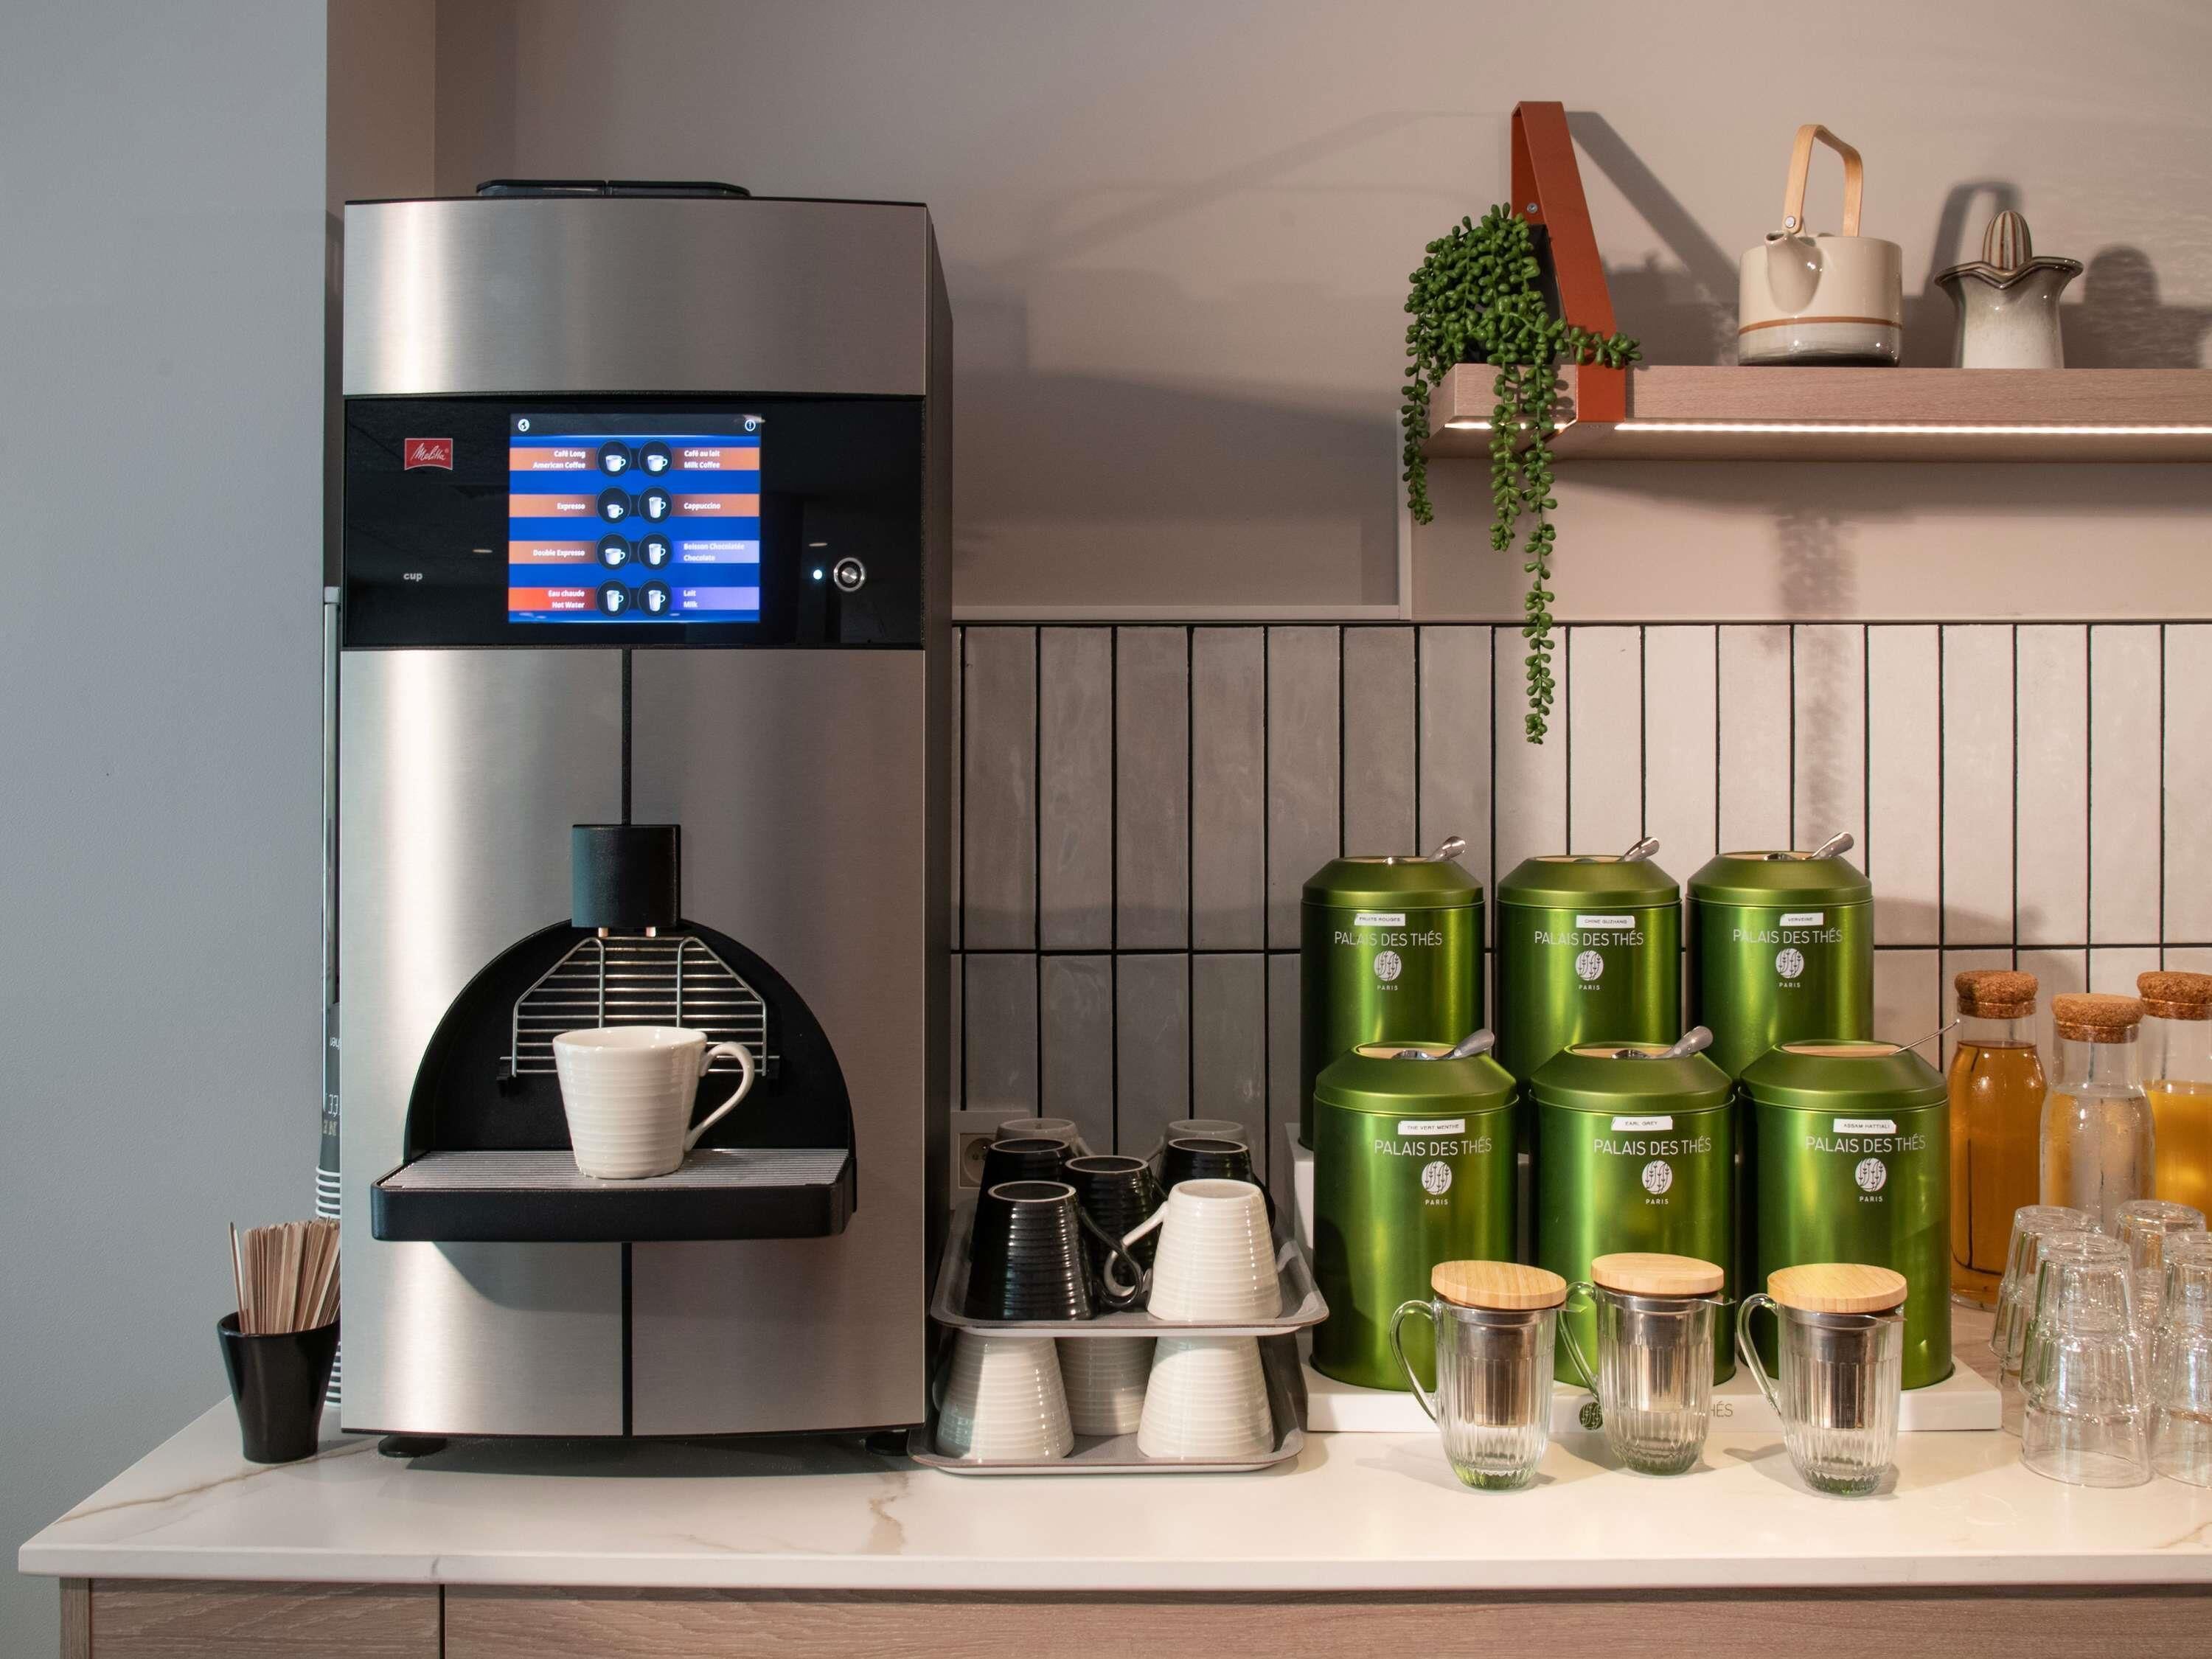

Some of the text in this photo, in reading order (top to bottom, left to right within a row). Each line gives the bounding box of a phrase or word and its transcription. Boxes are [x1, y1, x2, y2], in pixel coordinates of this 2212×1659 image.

[569, 450, 585, 459] Long
[557, 503, 585, 511] Expresso
[684, 502, 721, 511] Cappuccino
[557, 549, 585, 558] Expresso
[403, 573, 422, 582] cup
[1335, 930, 1442, 947] PALAIS DES THÉS
[1534, 930, 1644, 946] PALAIS DES THÉS
[1733, 928, 1843, 944] PALAIS DES THÉS
[1374, 1136, 1492, 1156] PALAIS DES THÉS
[1593, 1135, 1711, 1155] PALAIS DES THÉS
[1806, 1133, 1927, 1153] PALAIS DES THÉS
[1711, 1400, 1733, 1417] HÉS
